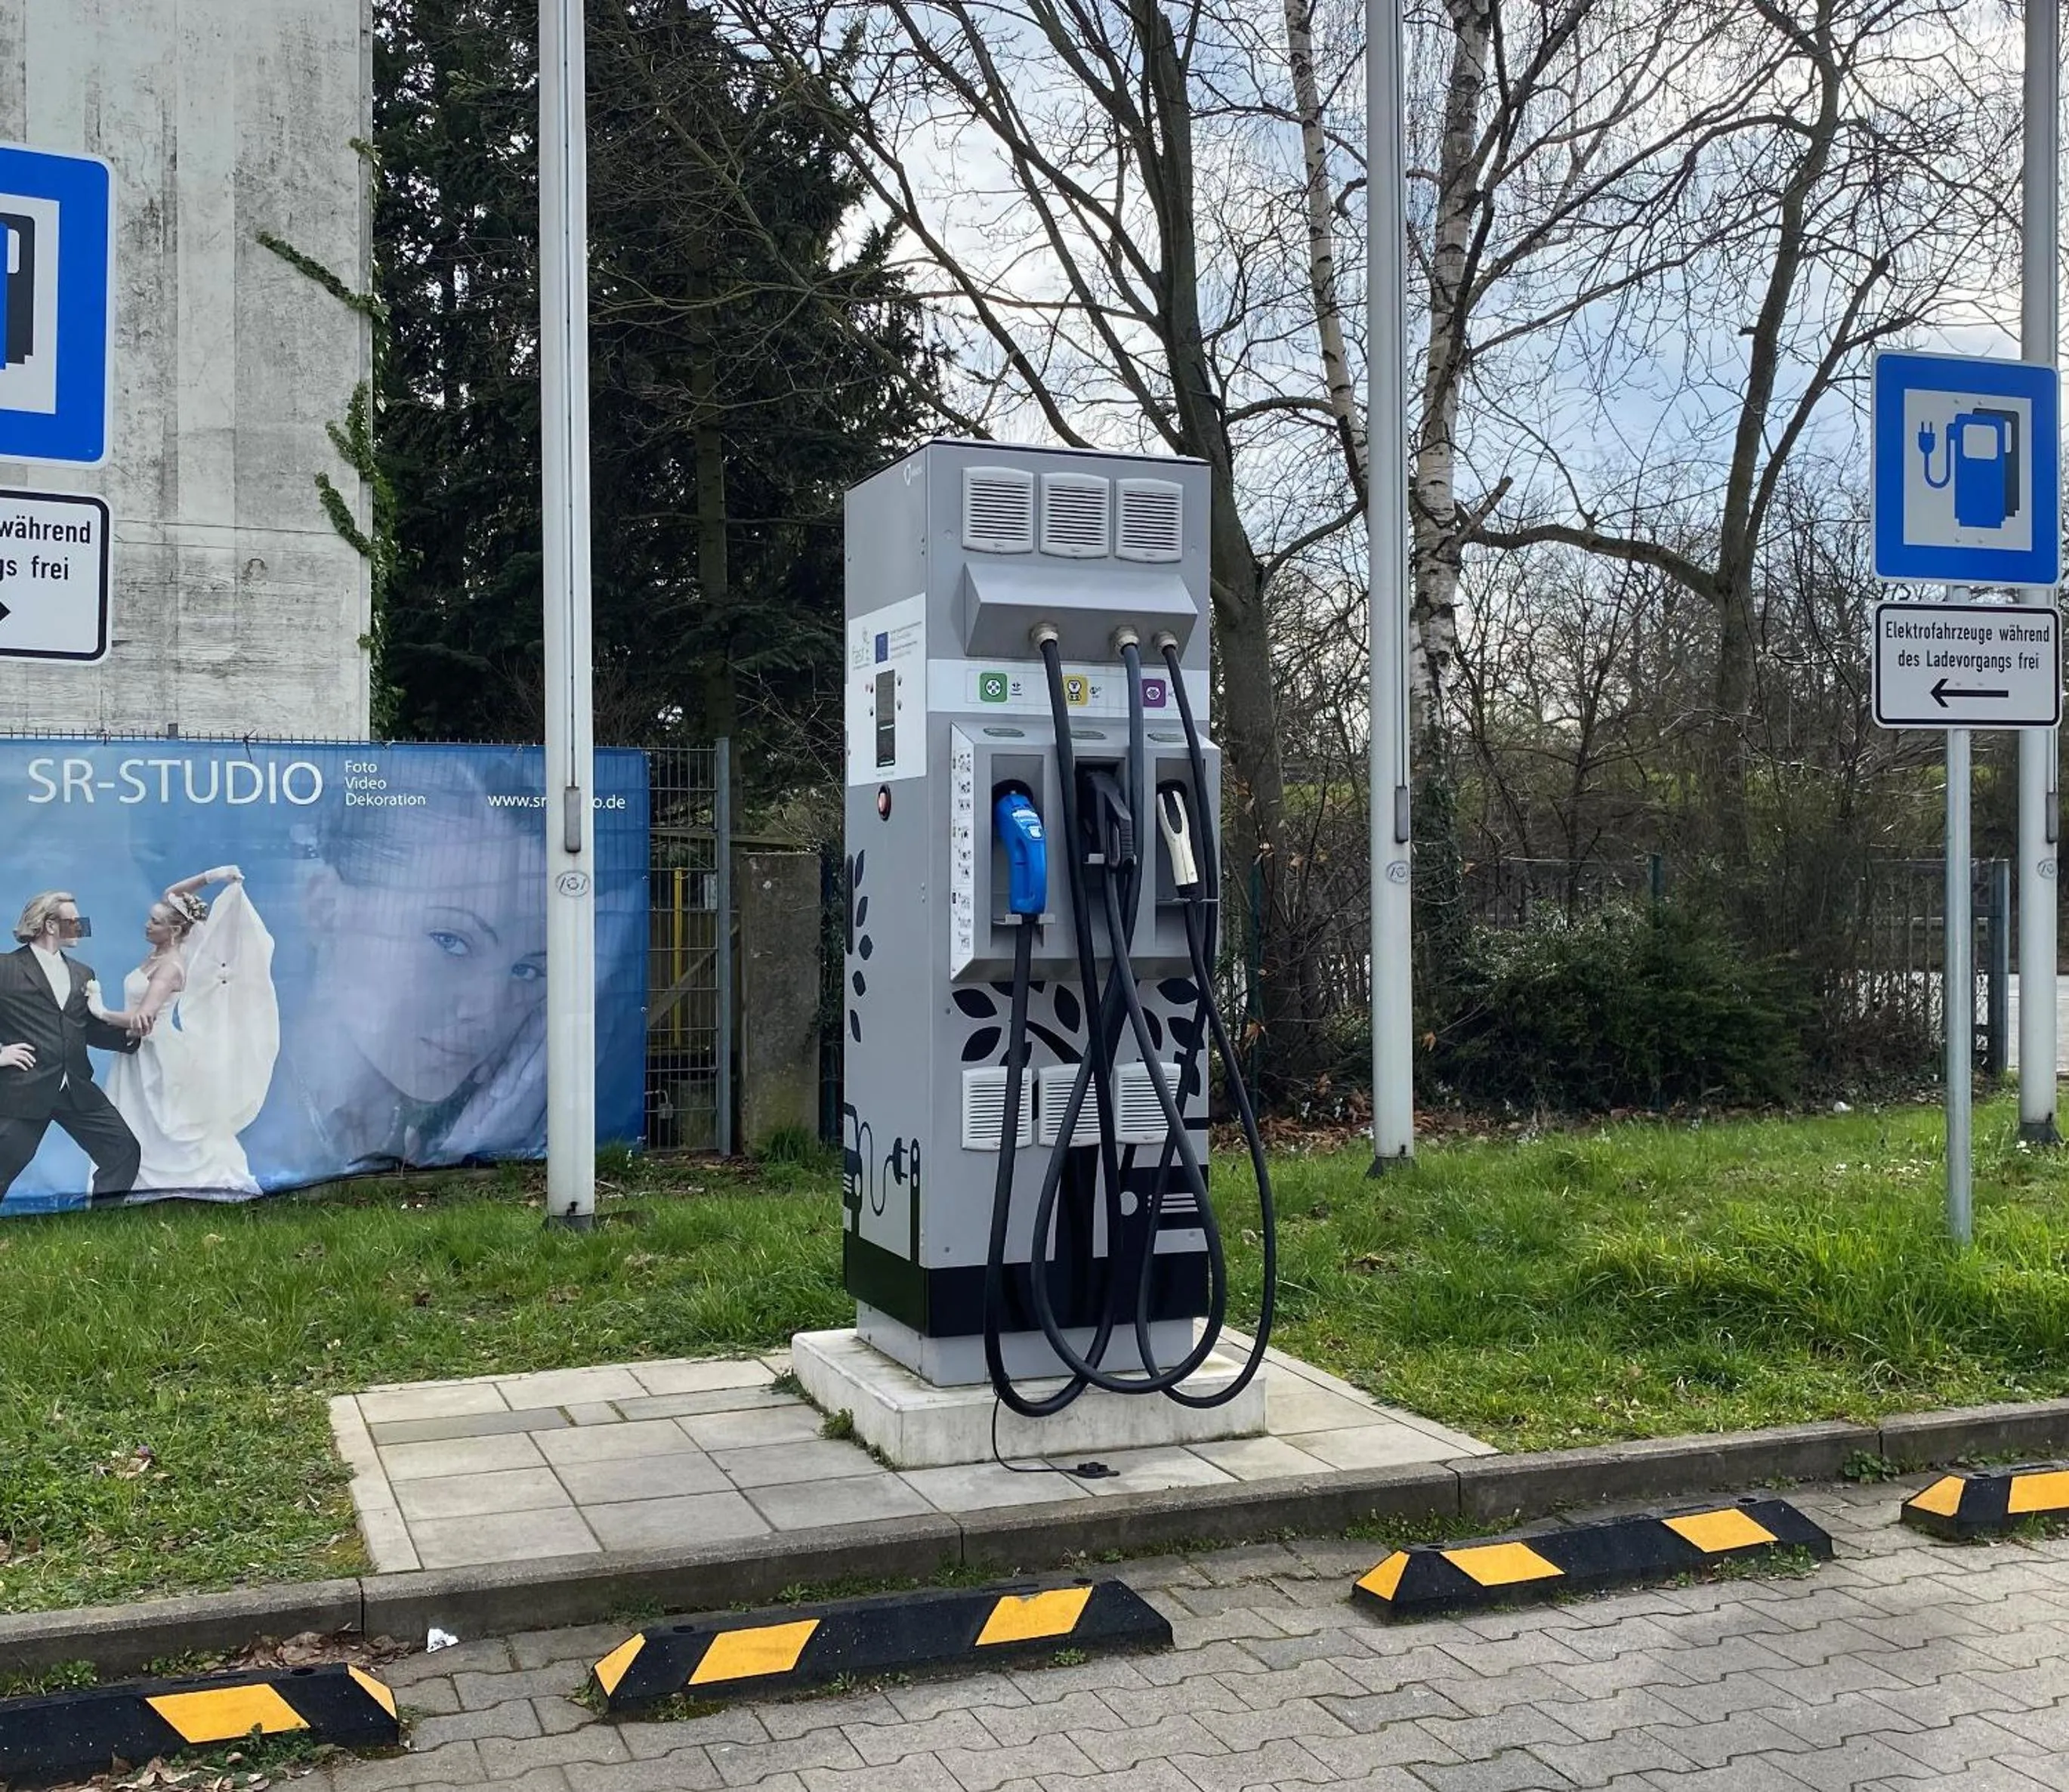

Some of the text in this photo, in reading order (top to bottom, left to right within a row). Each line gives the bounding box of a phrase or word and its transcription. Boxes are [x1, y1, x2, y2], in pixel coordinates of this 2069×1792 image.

[0, 514, 91, 544] während
[31, 555, 69, 580] frei
[1885, 621, 2050, 644] Elektrofahrzeuge während
[1898, 650, 2040, 672] des Ladevorgangs frei
[344, 760, 378, 773] Foto
[27, 758, 324, 805] SR-STUDIO
[344, 776, 387, 789] Video
[345, 792, 426, 806] Dekoration
